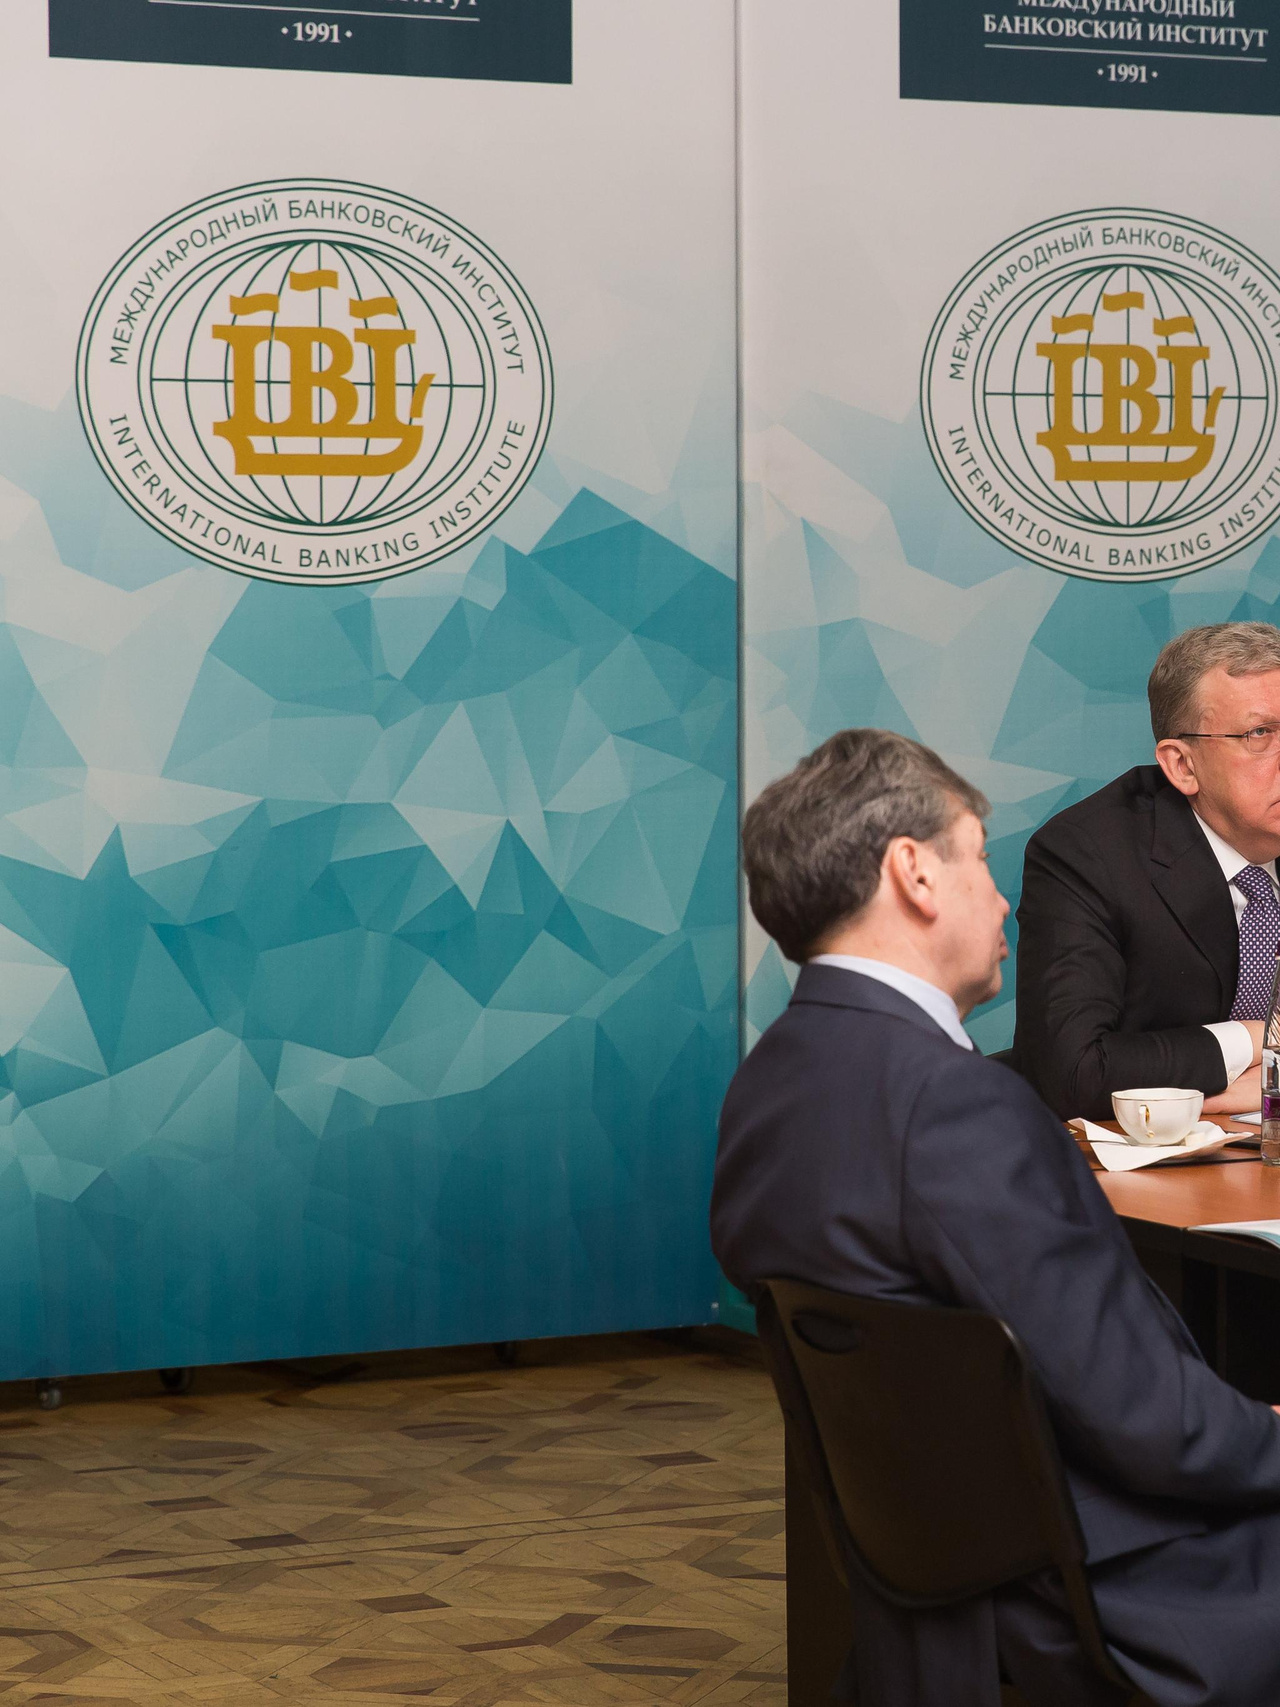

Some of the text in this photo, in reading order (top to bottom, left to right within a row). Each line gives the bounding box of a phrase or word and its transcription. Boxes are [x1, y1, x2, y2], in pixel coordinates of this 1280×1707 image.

[983, 14, 1268, 51] БАНКОВСКИЙ ИНСТИТУТ
[110, 198, 525, 375] МЕЖДУНАРОДНЫЙ БАНКОВСКИЙ ИНСТИТУТ
[948, 226, 1094, 380] МЕЖДУНАРОДНЫЙ
[1101, 227, 1241, 281] БАНКОВСКИЙ
[109, 413, 526, 568] INTERNATIONAL BANKING INSTITUTE
[948, 425, 1095, 563] INTERNATIONAL
[1108, 532, 1212, 566] BANKING
